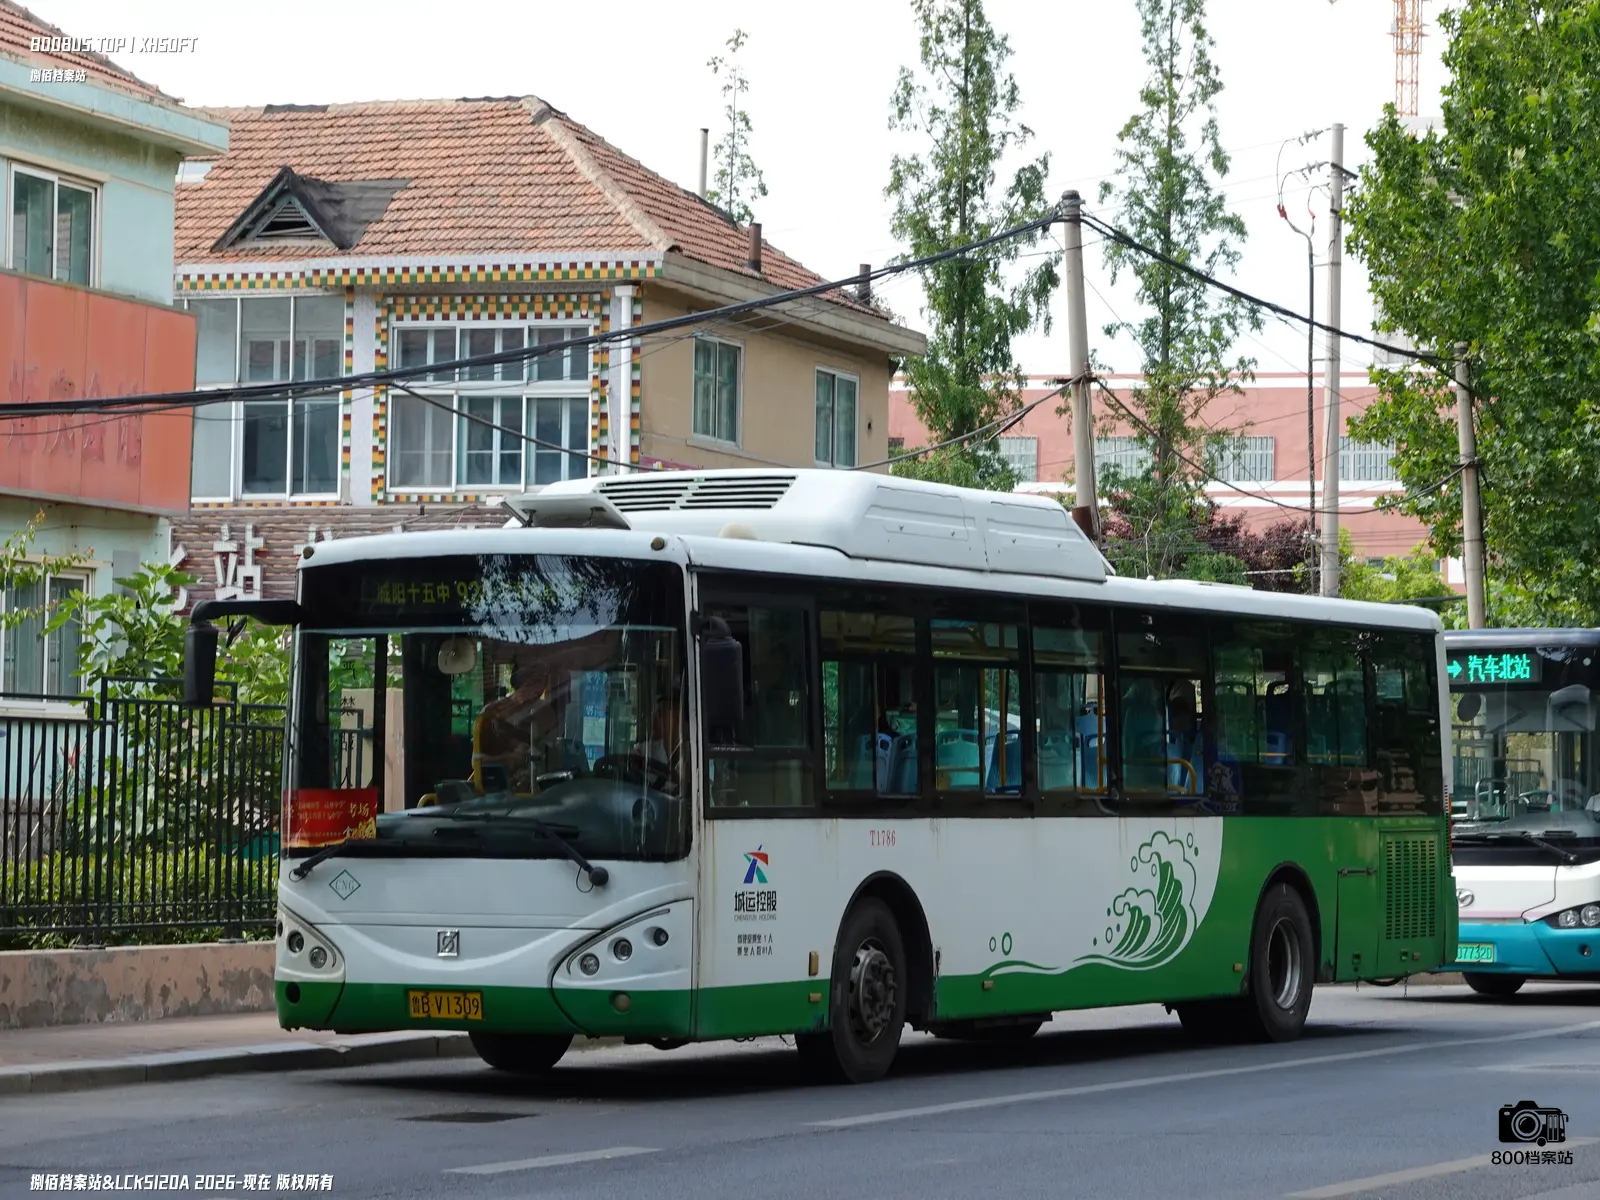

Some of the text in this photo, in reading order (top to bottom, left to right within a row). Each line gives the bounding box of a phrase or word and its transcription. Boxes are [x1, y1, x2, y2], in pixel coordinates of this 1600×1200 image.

[1468, 653, 1530, 682] 汽车北站
[870, 829, 896, 846] T1786
[335, 879, 355, 892] CNG
[734, 891, 777, 912] 城运控股
